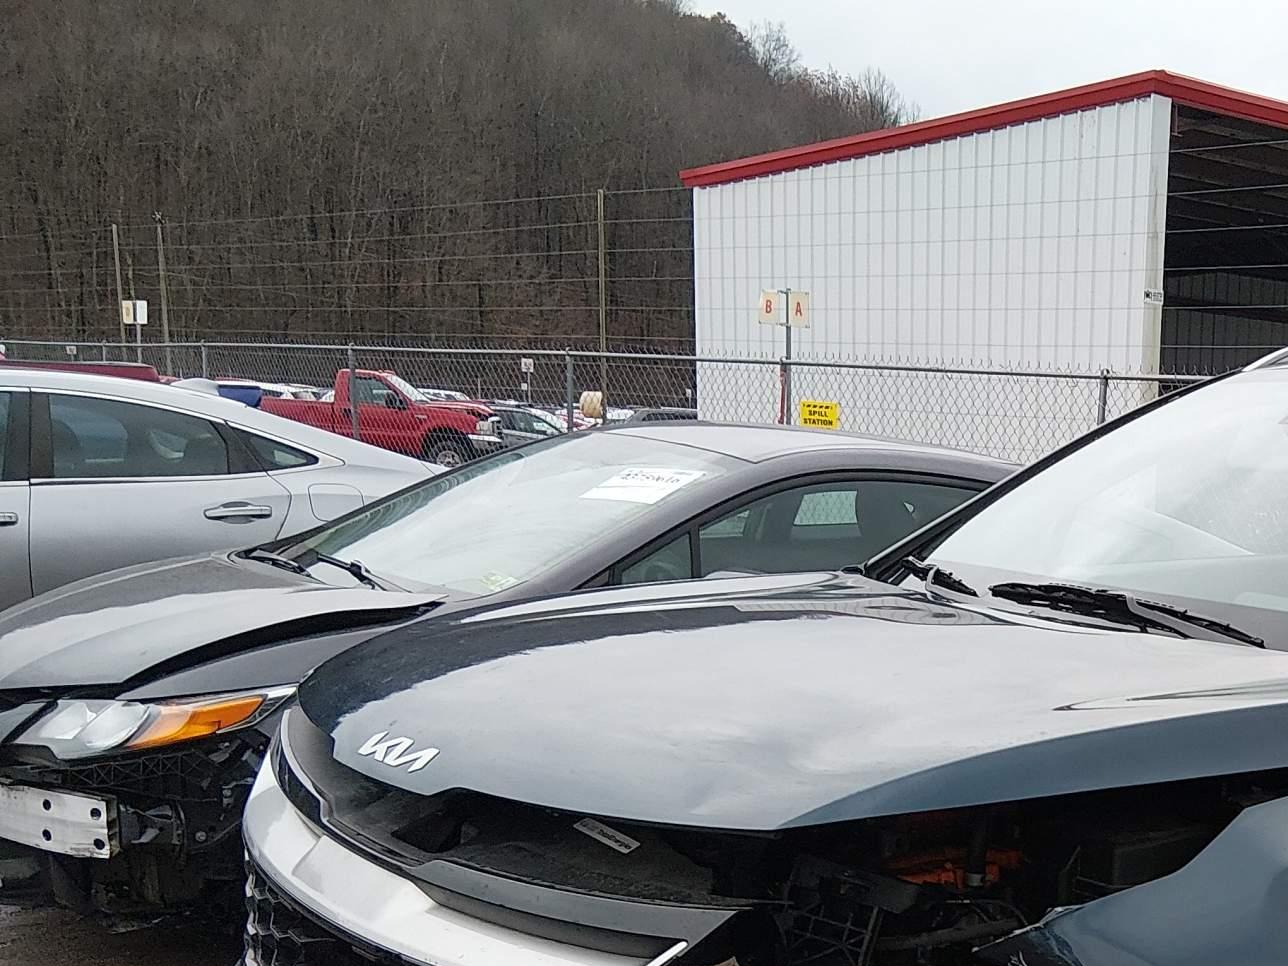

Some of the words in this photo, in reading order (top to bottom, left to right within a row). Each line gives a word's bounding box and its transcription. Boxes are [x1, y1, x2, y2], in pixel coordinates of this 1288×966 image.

[765, 299, 773, 314] B
[795, 301, 803, 317] A
[808, 409, 829, 418] SPILL
[803, 417, 833, 426] STATION
[357, 730, 441, 774] KIA
